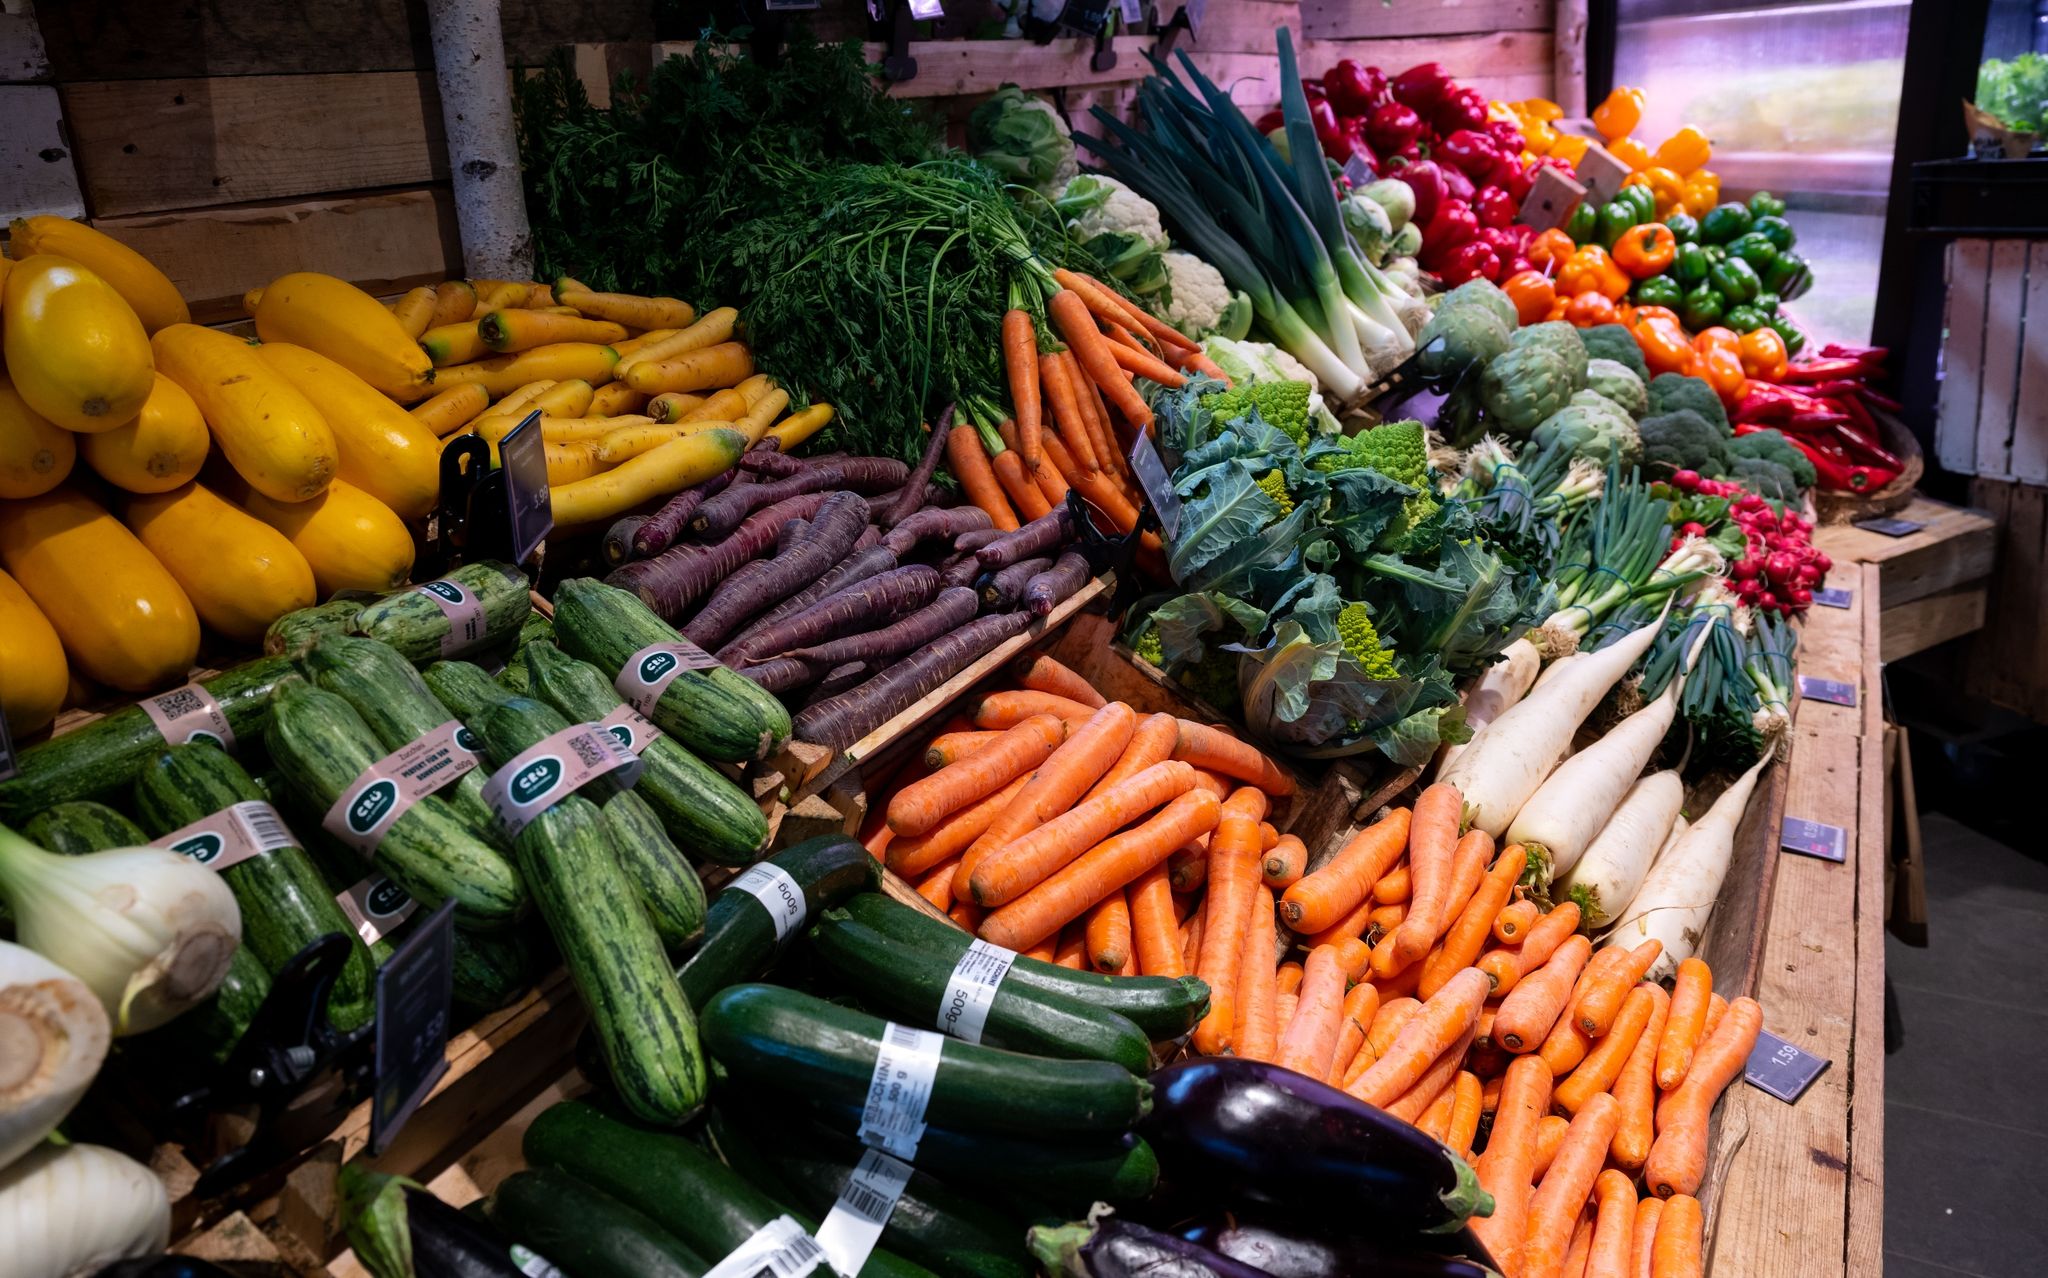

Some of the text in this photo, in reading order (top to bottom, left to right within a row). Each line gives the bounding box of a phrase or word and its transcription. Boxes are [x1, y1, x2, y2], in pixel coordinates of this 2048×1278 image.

[646, 656, 666, 671] CRÜ
[398, 742, 426, 761] Zucchini
[519, 765, 549, 789] CRÜ
[356, 790, 383, 817] CRÜ
[778, 882, 799, 915] 500g
[945, 989, 968, 1023] 500g
[1771, 1045, 1799, 1067] 1.59
